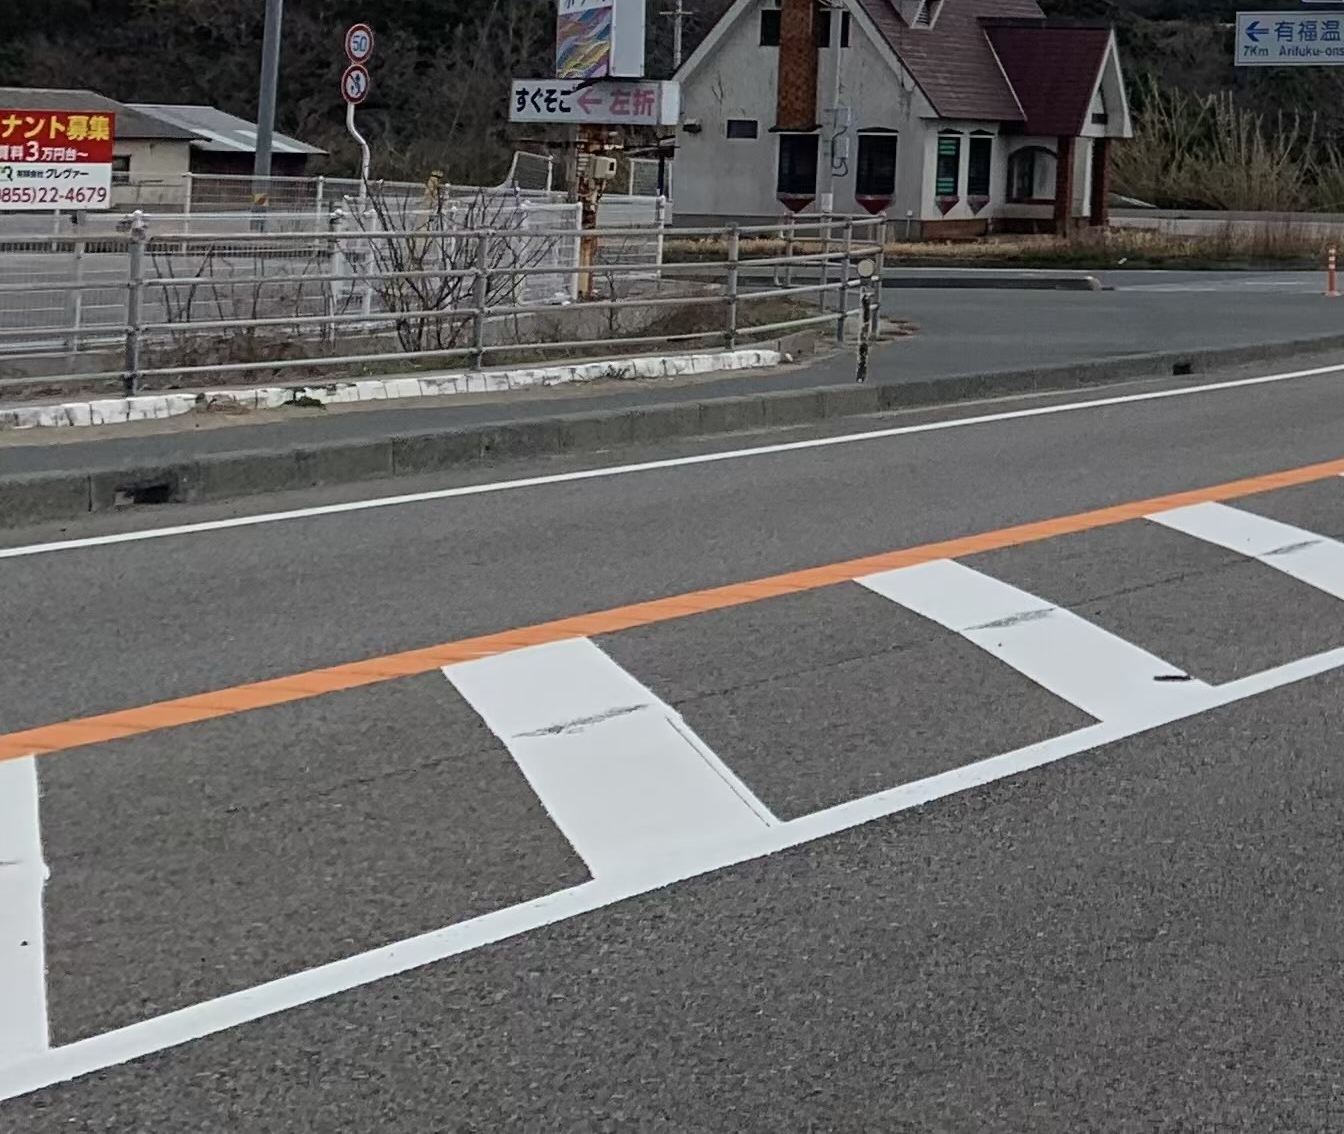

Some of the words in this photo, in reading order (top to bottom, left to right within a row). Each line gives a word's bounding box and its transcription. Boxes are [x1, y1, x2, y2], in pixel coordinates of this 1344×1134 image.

[352, 35, 367, 52] 50
[515, 87, 573, 114] すぐそこ
[609, 89, 656, 116] 左折
[46, 168, 89, 179] クレヴァー
[0, 186, 107, 204] 855)22-4679
